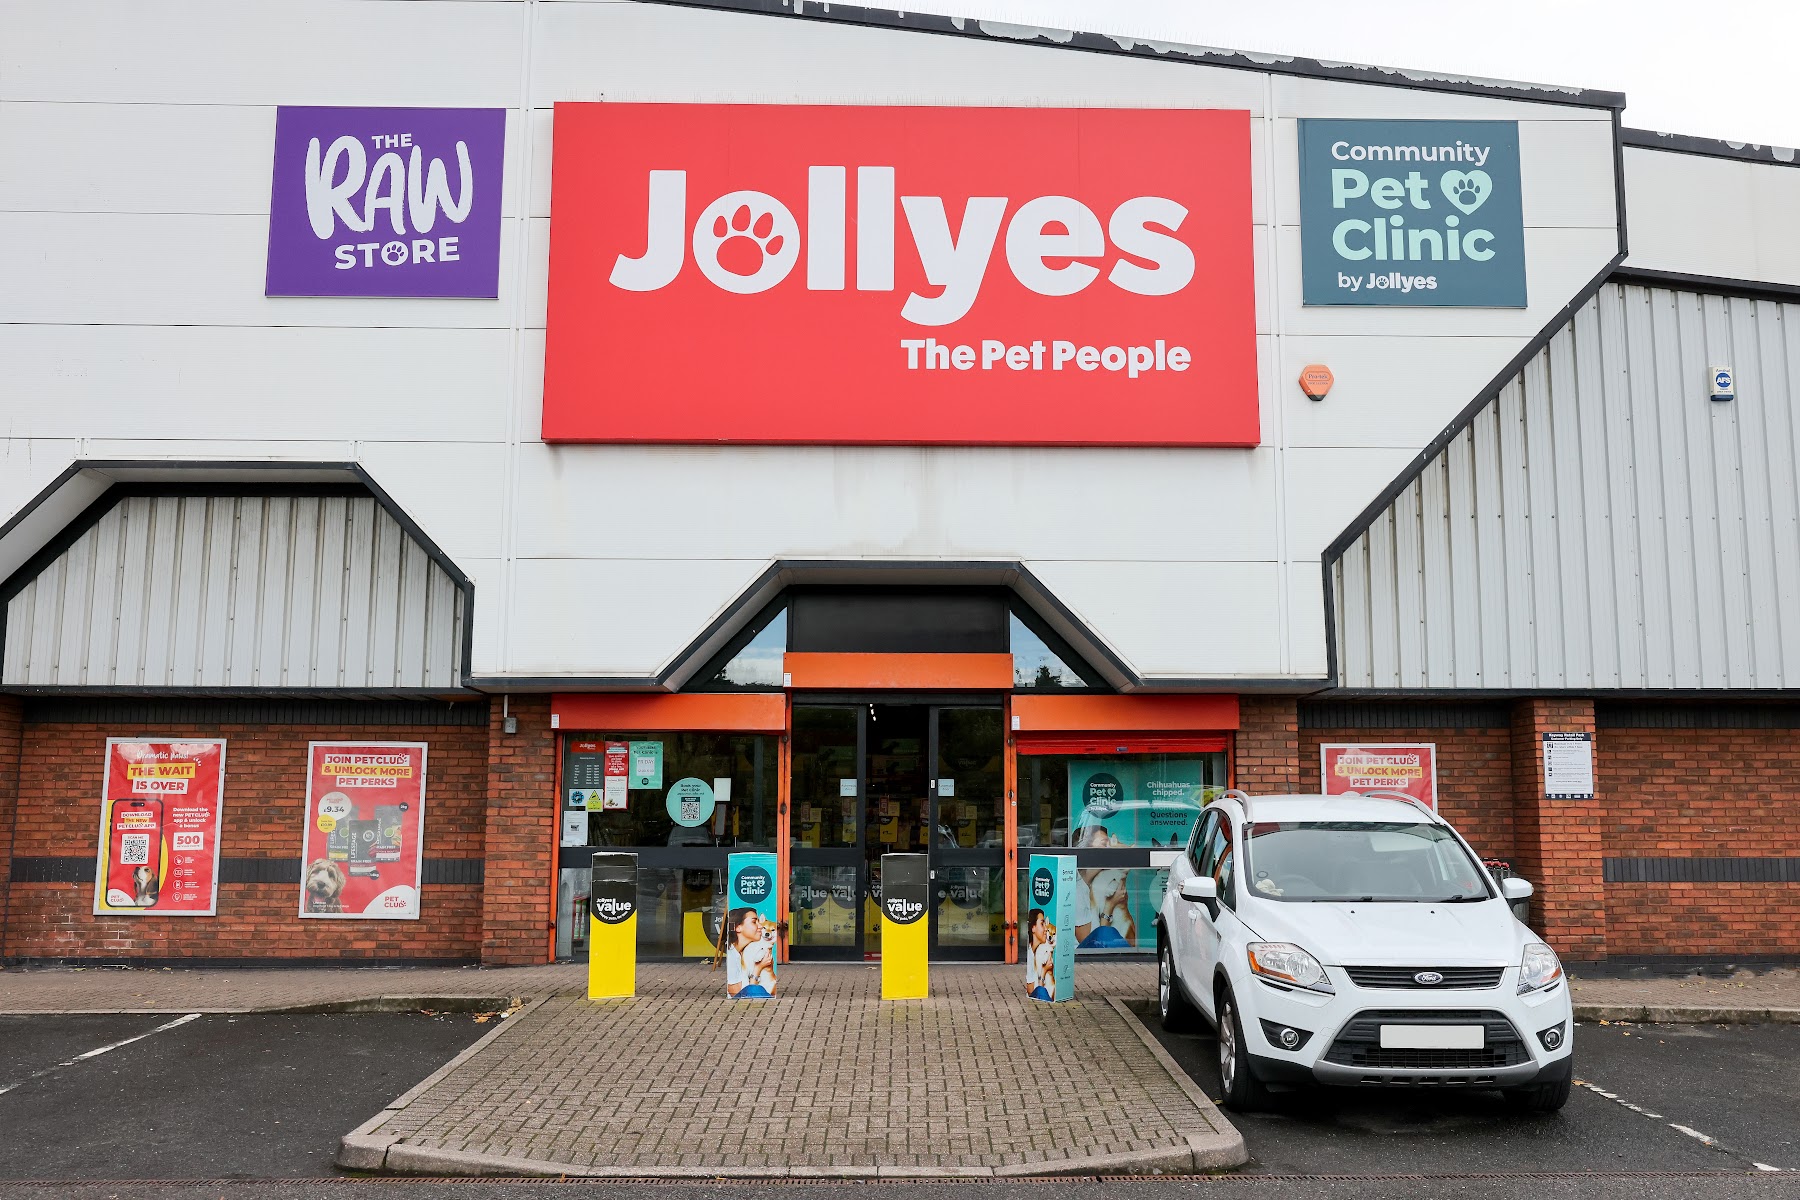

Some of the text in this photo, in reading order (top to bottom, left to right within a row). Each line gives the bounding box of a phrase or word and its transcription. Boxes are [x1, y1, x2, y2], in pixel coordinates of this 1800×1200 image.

[372, 133, 413, 149] THE
[1331, 140, 1491, 167] Community
[305, 135, 473, 240] RAW
[1331, 168, 1432, 210] Pet
[608, 165, 1196, 327] Jollyes
[1332, 214, 1496, 262] Clinic
[334, 236, 460, 270] STORE
[1338, 271, 1438, 293] by Jollyes
[900, 338, 1192, 379] The Pet People
[130, 766, 192, 776] THE WAIT
[334, 766, 377, 775] UNLOCK
[380, 767, 410, 776] MORE
[1347, 767, 1388, 775] UNLOCK
[1391, 768, 1420, 776] MORE
[136, 781, 185, 790] IS OVER
[361, 778, 395, 786] PERKS
[1090, 796, 1116, 805] Clinic
[1152, 789, 1184, 797] chipped.
[177, 836, 200, 844] 500
[1035, 889, 1050, 897] Clinic
[597, 898, 631, 915] value
[887, 899, 922, 916] value
